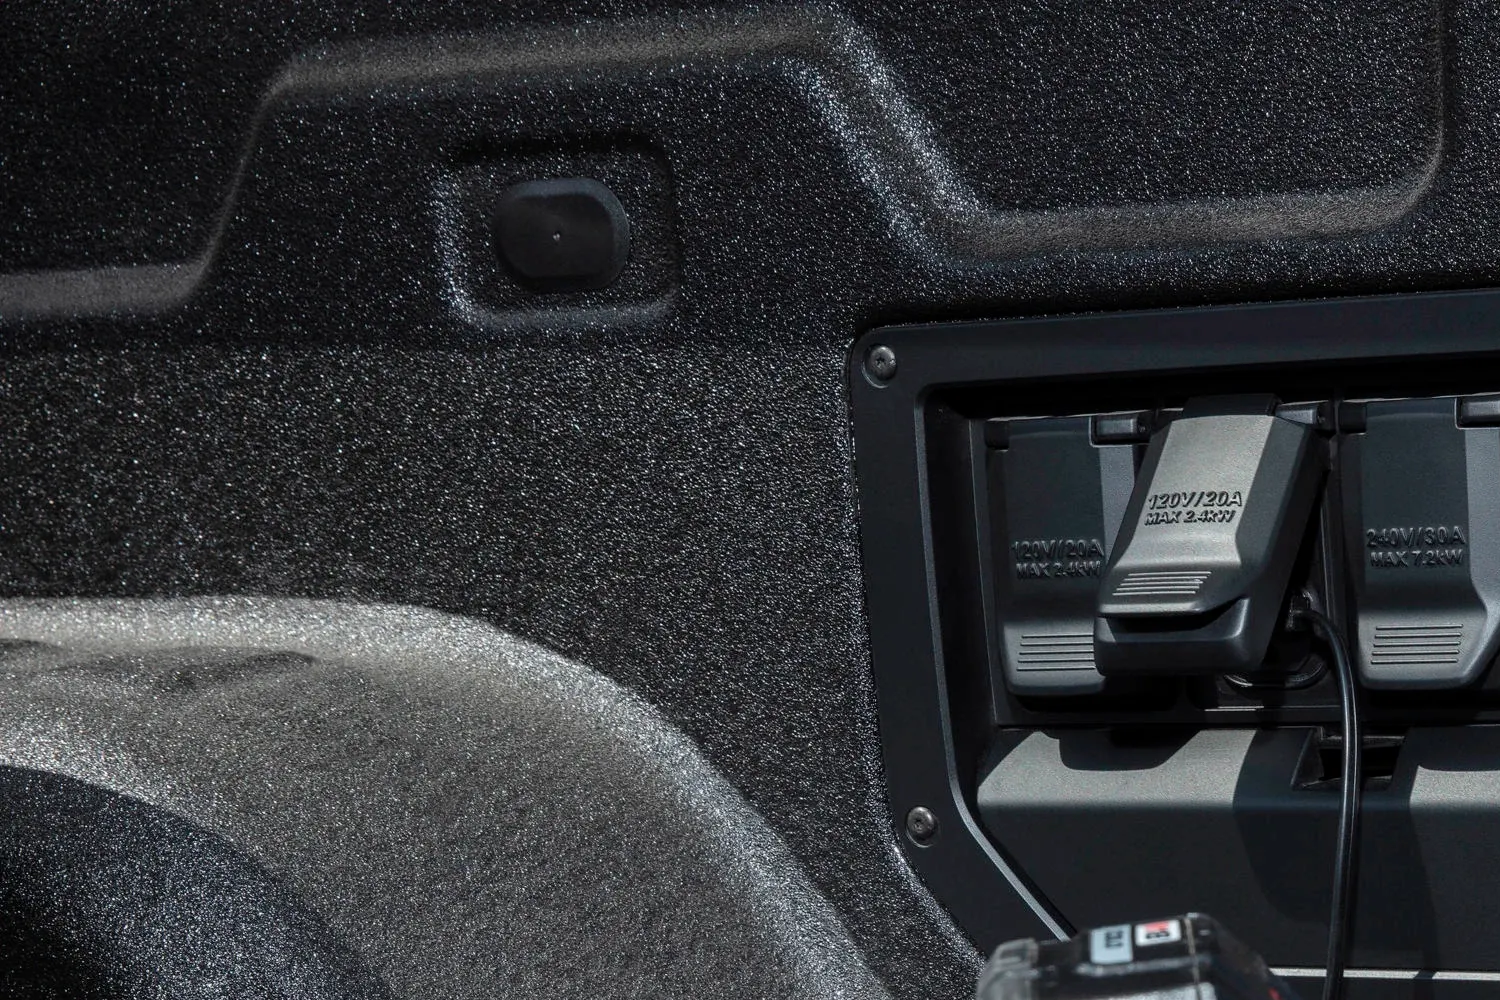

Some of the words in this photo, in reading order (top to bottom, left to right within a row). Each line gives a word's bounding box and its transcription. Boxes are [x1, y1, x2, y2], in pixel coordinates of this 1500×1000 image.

[1148, 491, 1243, 510] 120V/20A
[1144, 510, 1182, 526] MAX
[1183, 509, 1236, 524] 2.4kW
[1366, 526, 1466, 547] 240V/30A
[1370, 550, 1408, 567] MAX
[1015, 561, 1050, 579] MAX
